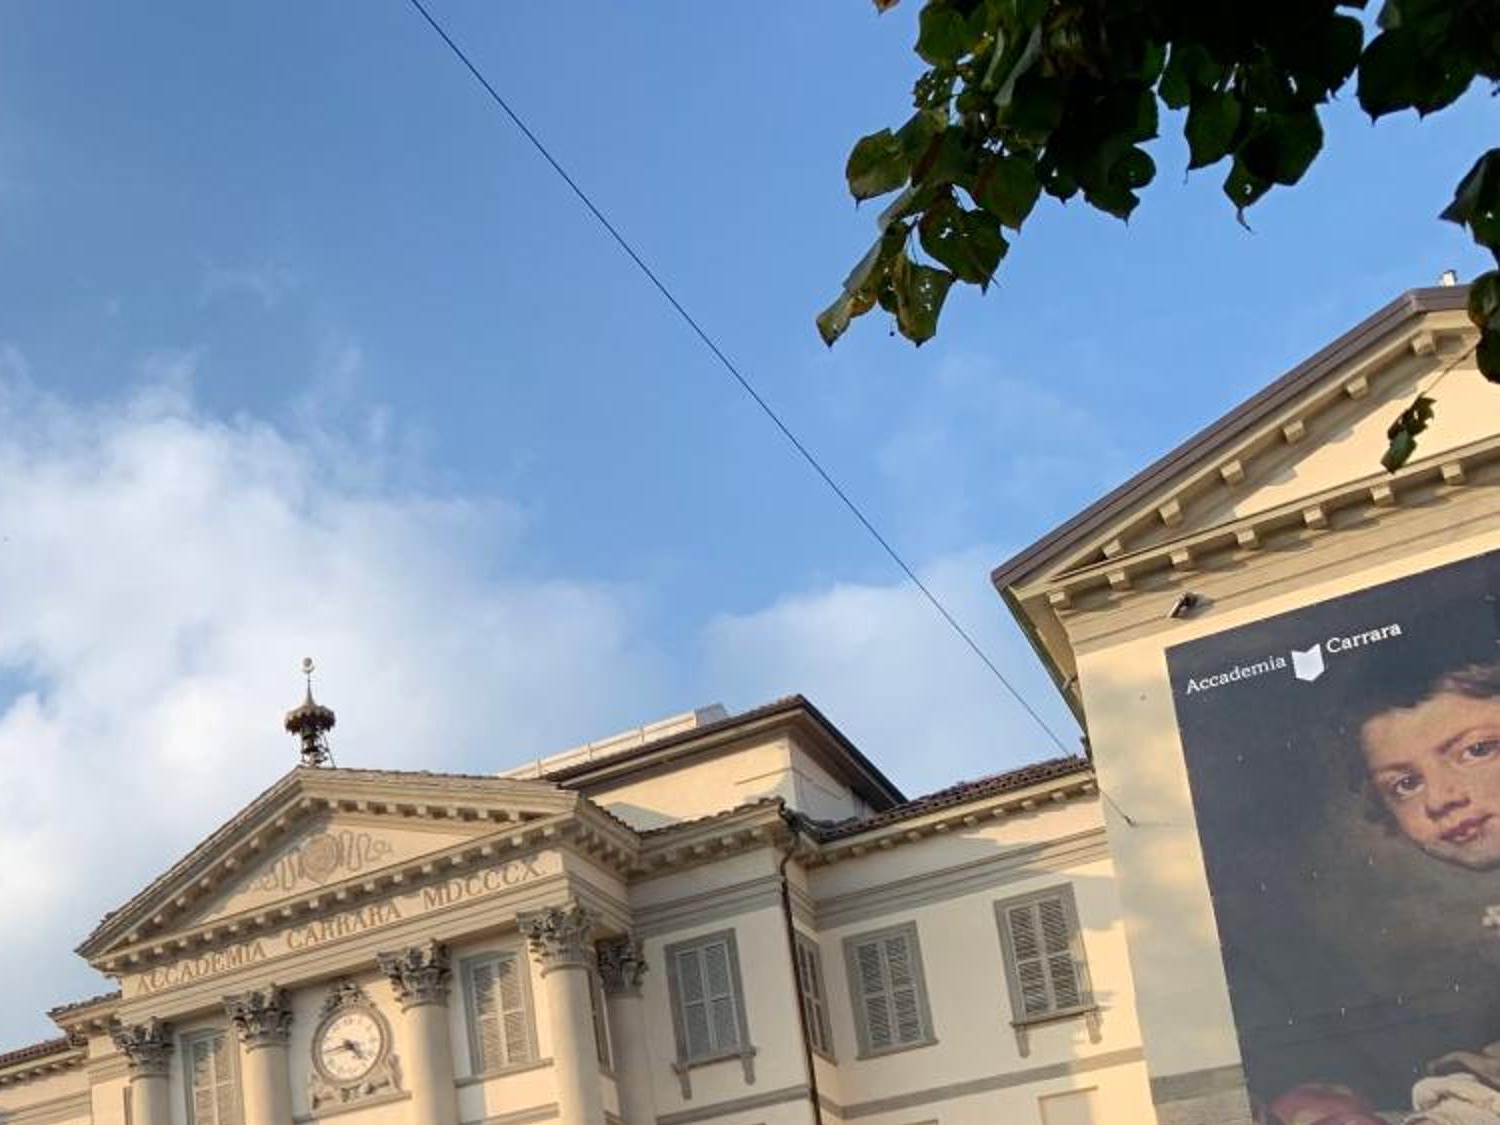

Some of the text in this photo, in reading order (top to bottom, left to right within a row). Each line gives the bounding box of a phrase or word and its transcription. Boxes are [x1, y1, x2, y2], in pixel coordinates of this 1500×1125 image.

[1186, 622, 1403, 695] Accademia Carrara
[135, 940, 267, 994] ACCADEMIA
[285, 902, 402, 951] CARRARA
